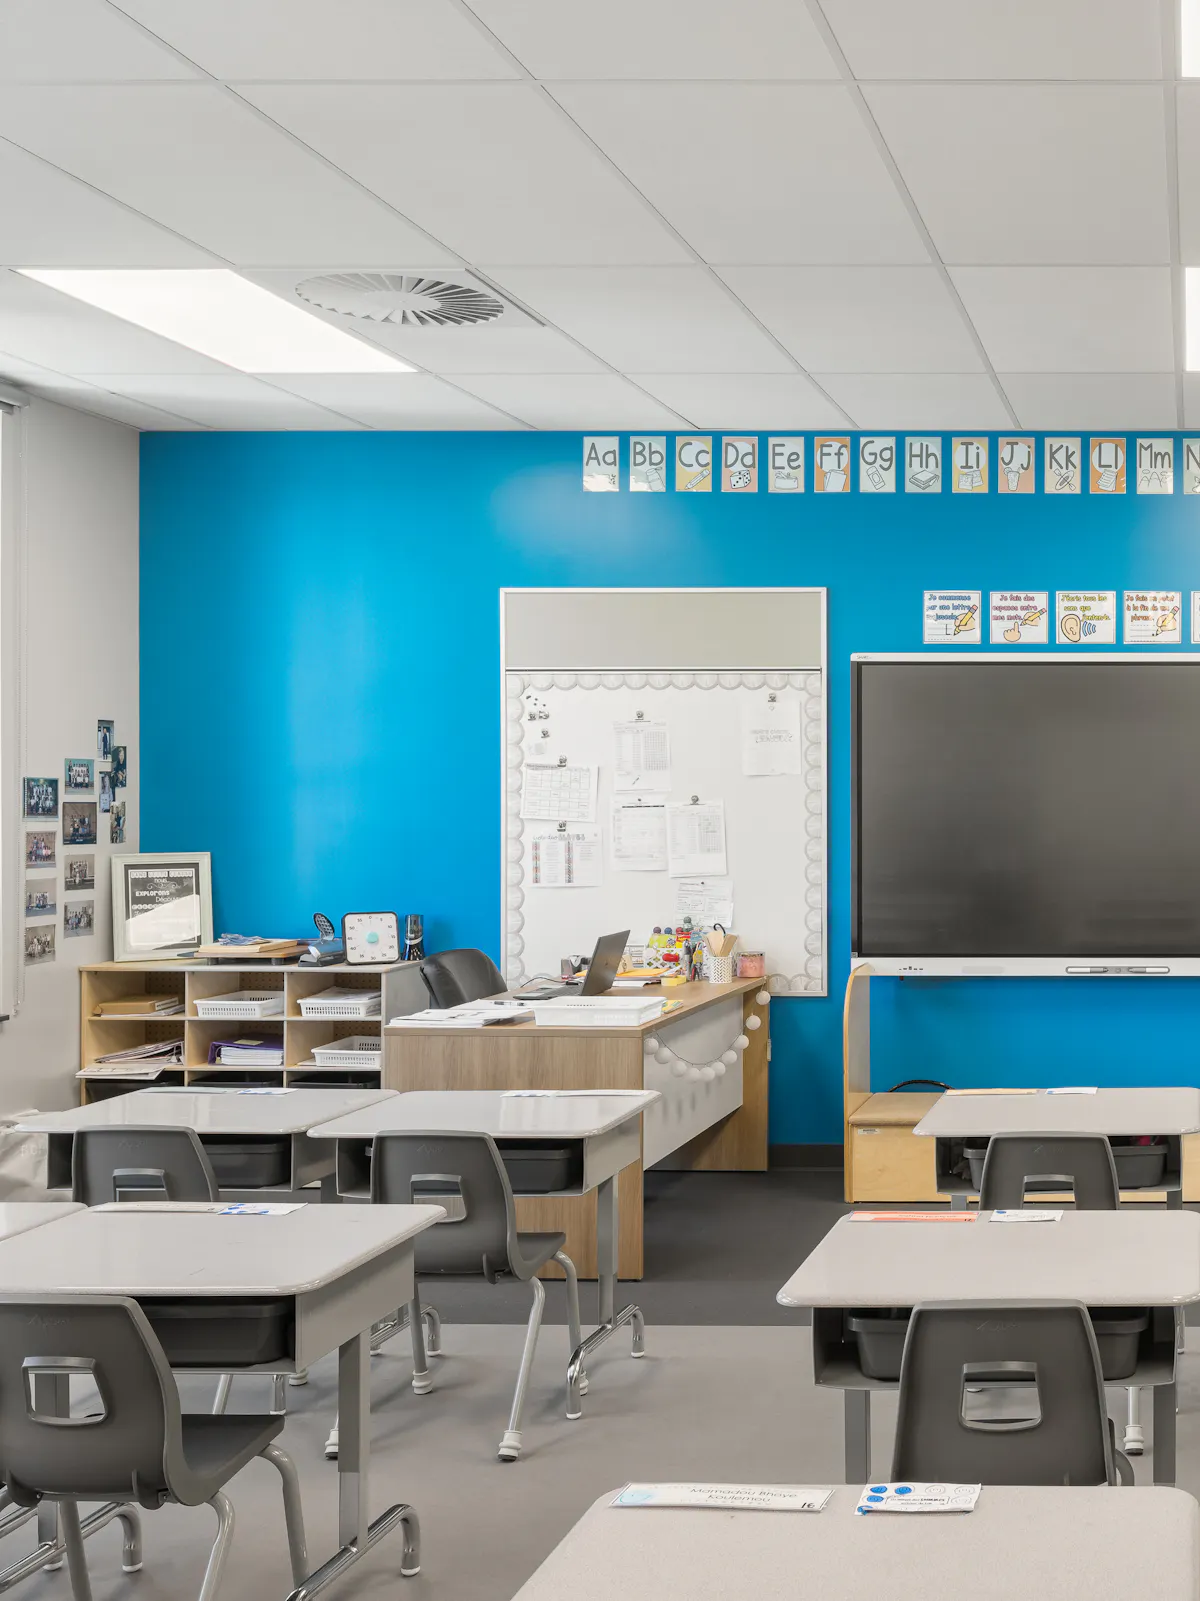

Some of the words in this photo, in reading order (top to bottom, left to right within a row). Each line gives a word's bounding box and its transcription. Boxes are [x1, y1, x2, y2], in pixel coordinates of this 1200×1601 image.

[586, 443, 617, 467] Aa
[633, 441, 664, 467] Bb
[678, 442, 710, 468] Cc
[725, 442, 756, 468] Dd
[772, 444, 801, 470] Ee
[820, 443, 848, 469] Ff
[861, 440, 894, 471] Gg
[909, 442, 939, 468] Hh
[1001, 442, 1031, 471] Jj
[1049, 444, 1077, 470] Kk
[1139, 443, 1171, 469] Mm
